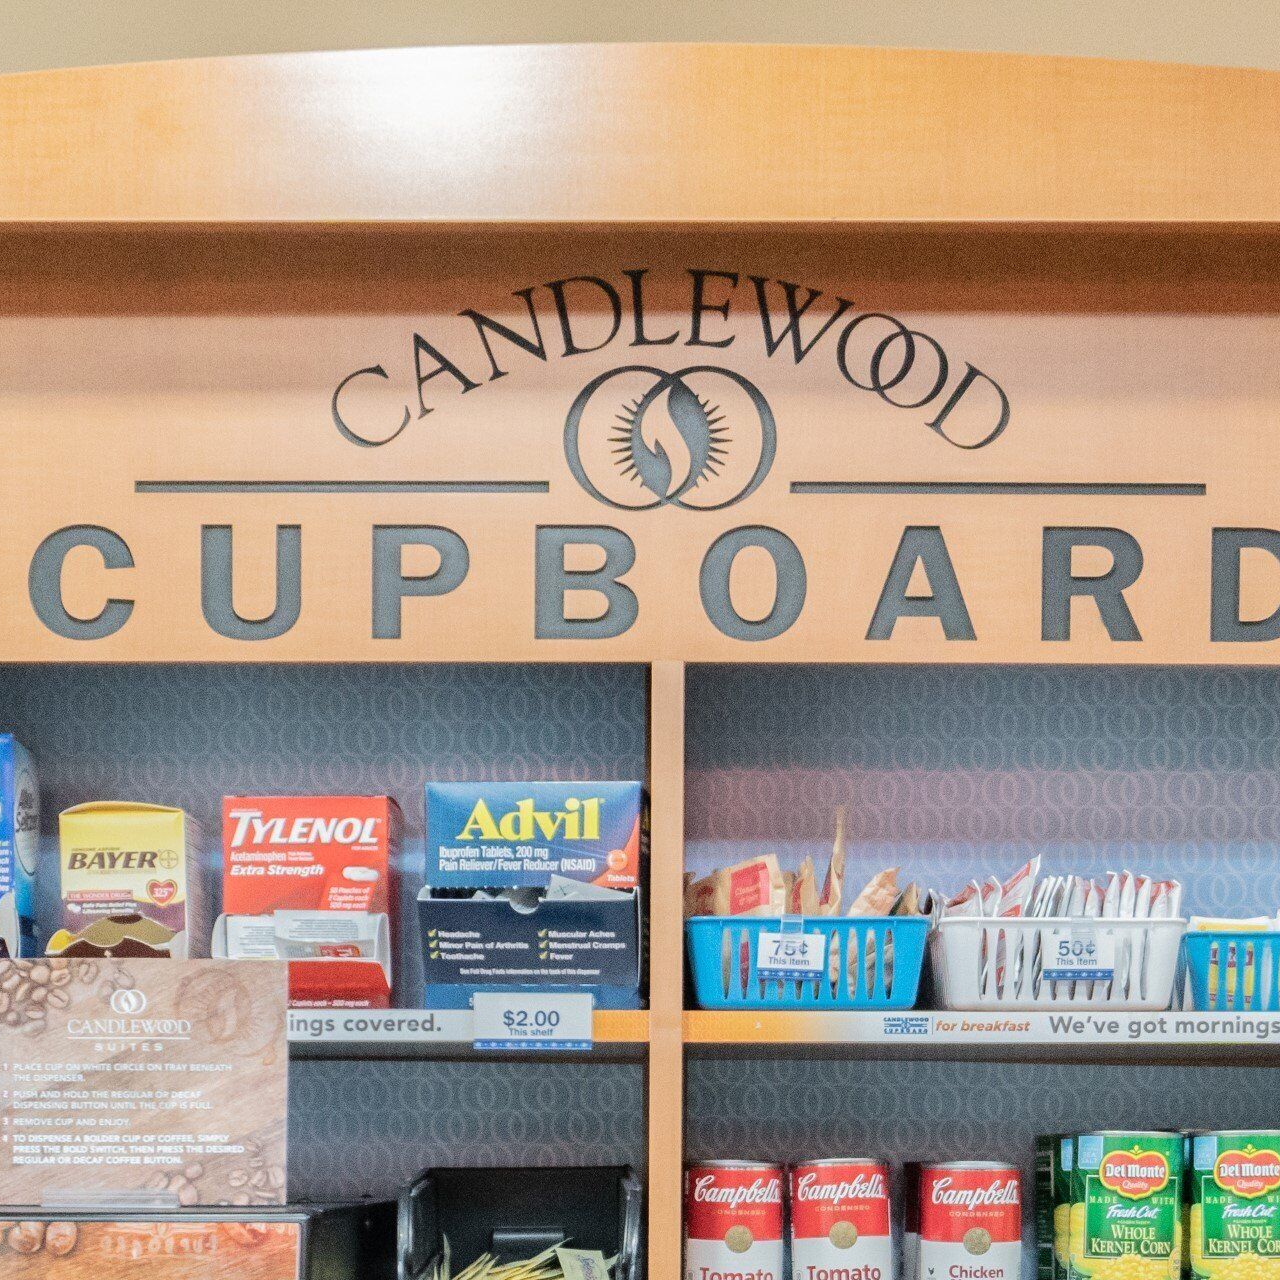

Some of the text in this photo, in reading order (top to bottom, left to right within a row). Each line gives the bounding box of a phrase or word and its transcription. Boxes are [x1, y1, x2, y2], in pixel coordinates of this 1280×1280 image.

[331, 267, 1011, 452] CANDLEWOOD
[455, 798, 600, 841] Advil
[229, 811, 379, 848] TYLENOL
[230, 852, 287, 862] Acetaminophen
[439, 846, 548, 859] Ibuprofen Tablets, 200 mg
[68, 851, 158, 870] BAYER
[439, 858, 596, 872] Pain Reliever/Fever Reducer (NSAID)
[231, 865, 324, 876] Extra Strength
[772, 939, 809, 957] 75¢
[1058, 939, 1096, 957] 50¢
[768, 957, 810, 966] This item
[503, 1010, 560, 1027] $2.00
[531, 1028, 553, 1036] shelf
[935, 1020, 959, 1033] for
[961, 1019, 1031, 1032] breakfast
[1049, 1016, 1120, 1034] We've
[1127, 1019, 1168, 1040] got
[94, 1043, 163, 1051] SUITES
[1105, 1164, 1165, 1179] Del Monte
[694, 1172, 781, 1208] Campbell's
[1110, 1225, 1156, 1240] WHOLE
[1227, 1225, 1272, 1240] WHOLE
[1091, 1238, 1171, 1255] KERNEL CORN
[1208, 1238, 1255, 1253] KERNEL
[948, 1265, 1004, 1279] Chicken
